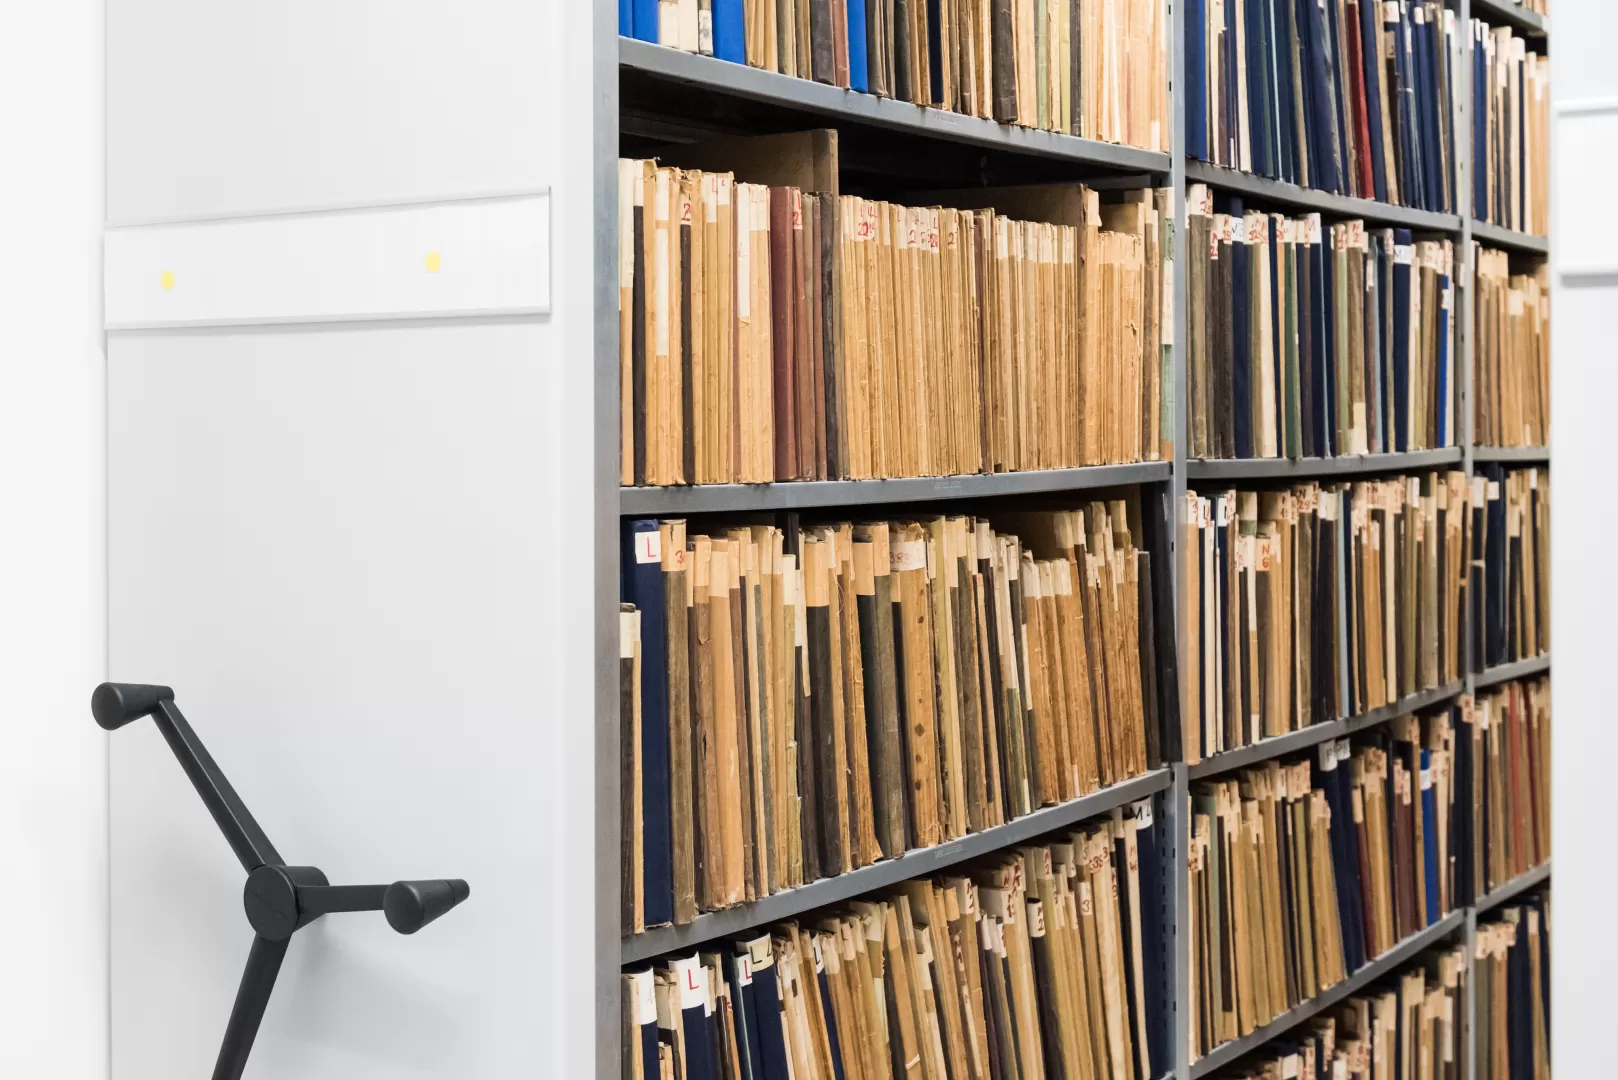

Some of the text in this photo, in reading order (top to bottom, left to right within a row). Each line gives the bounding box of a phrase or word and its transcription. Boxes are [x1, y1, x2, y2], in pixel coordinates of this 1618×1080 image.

[647, 535, 657, 558] L
[1262, 544, 1270, 555] N
[1262, 557, 1269, 569] 6
[749, 945, 763, 965] L
[688, 969, 700, 991] L
[743, 960, 753, 980] L
